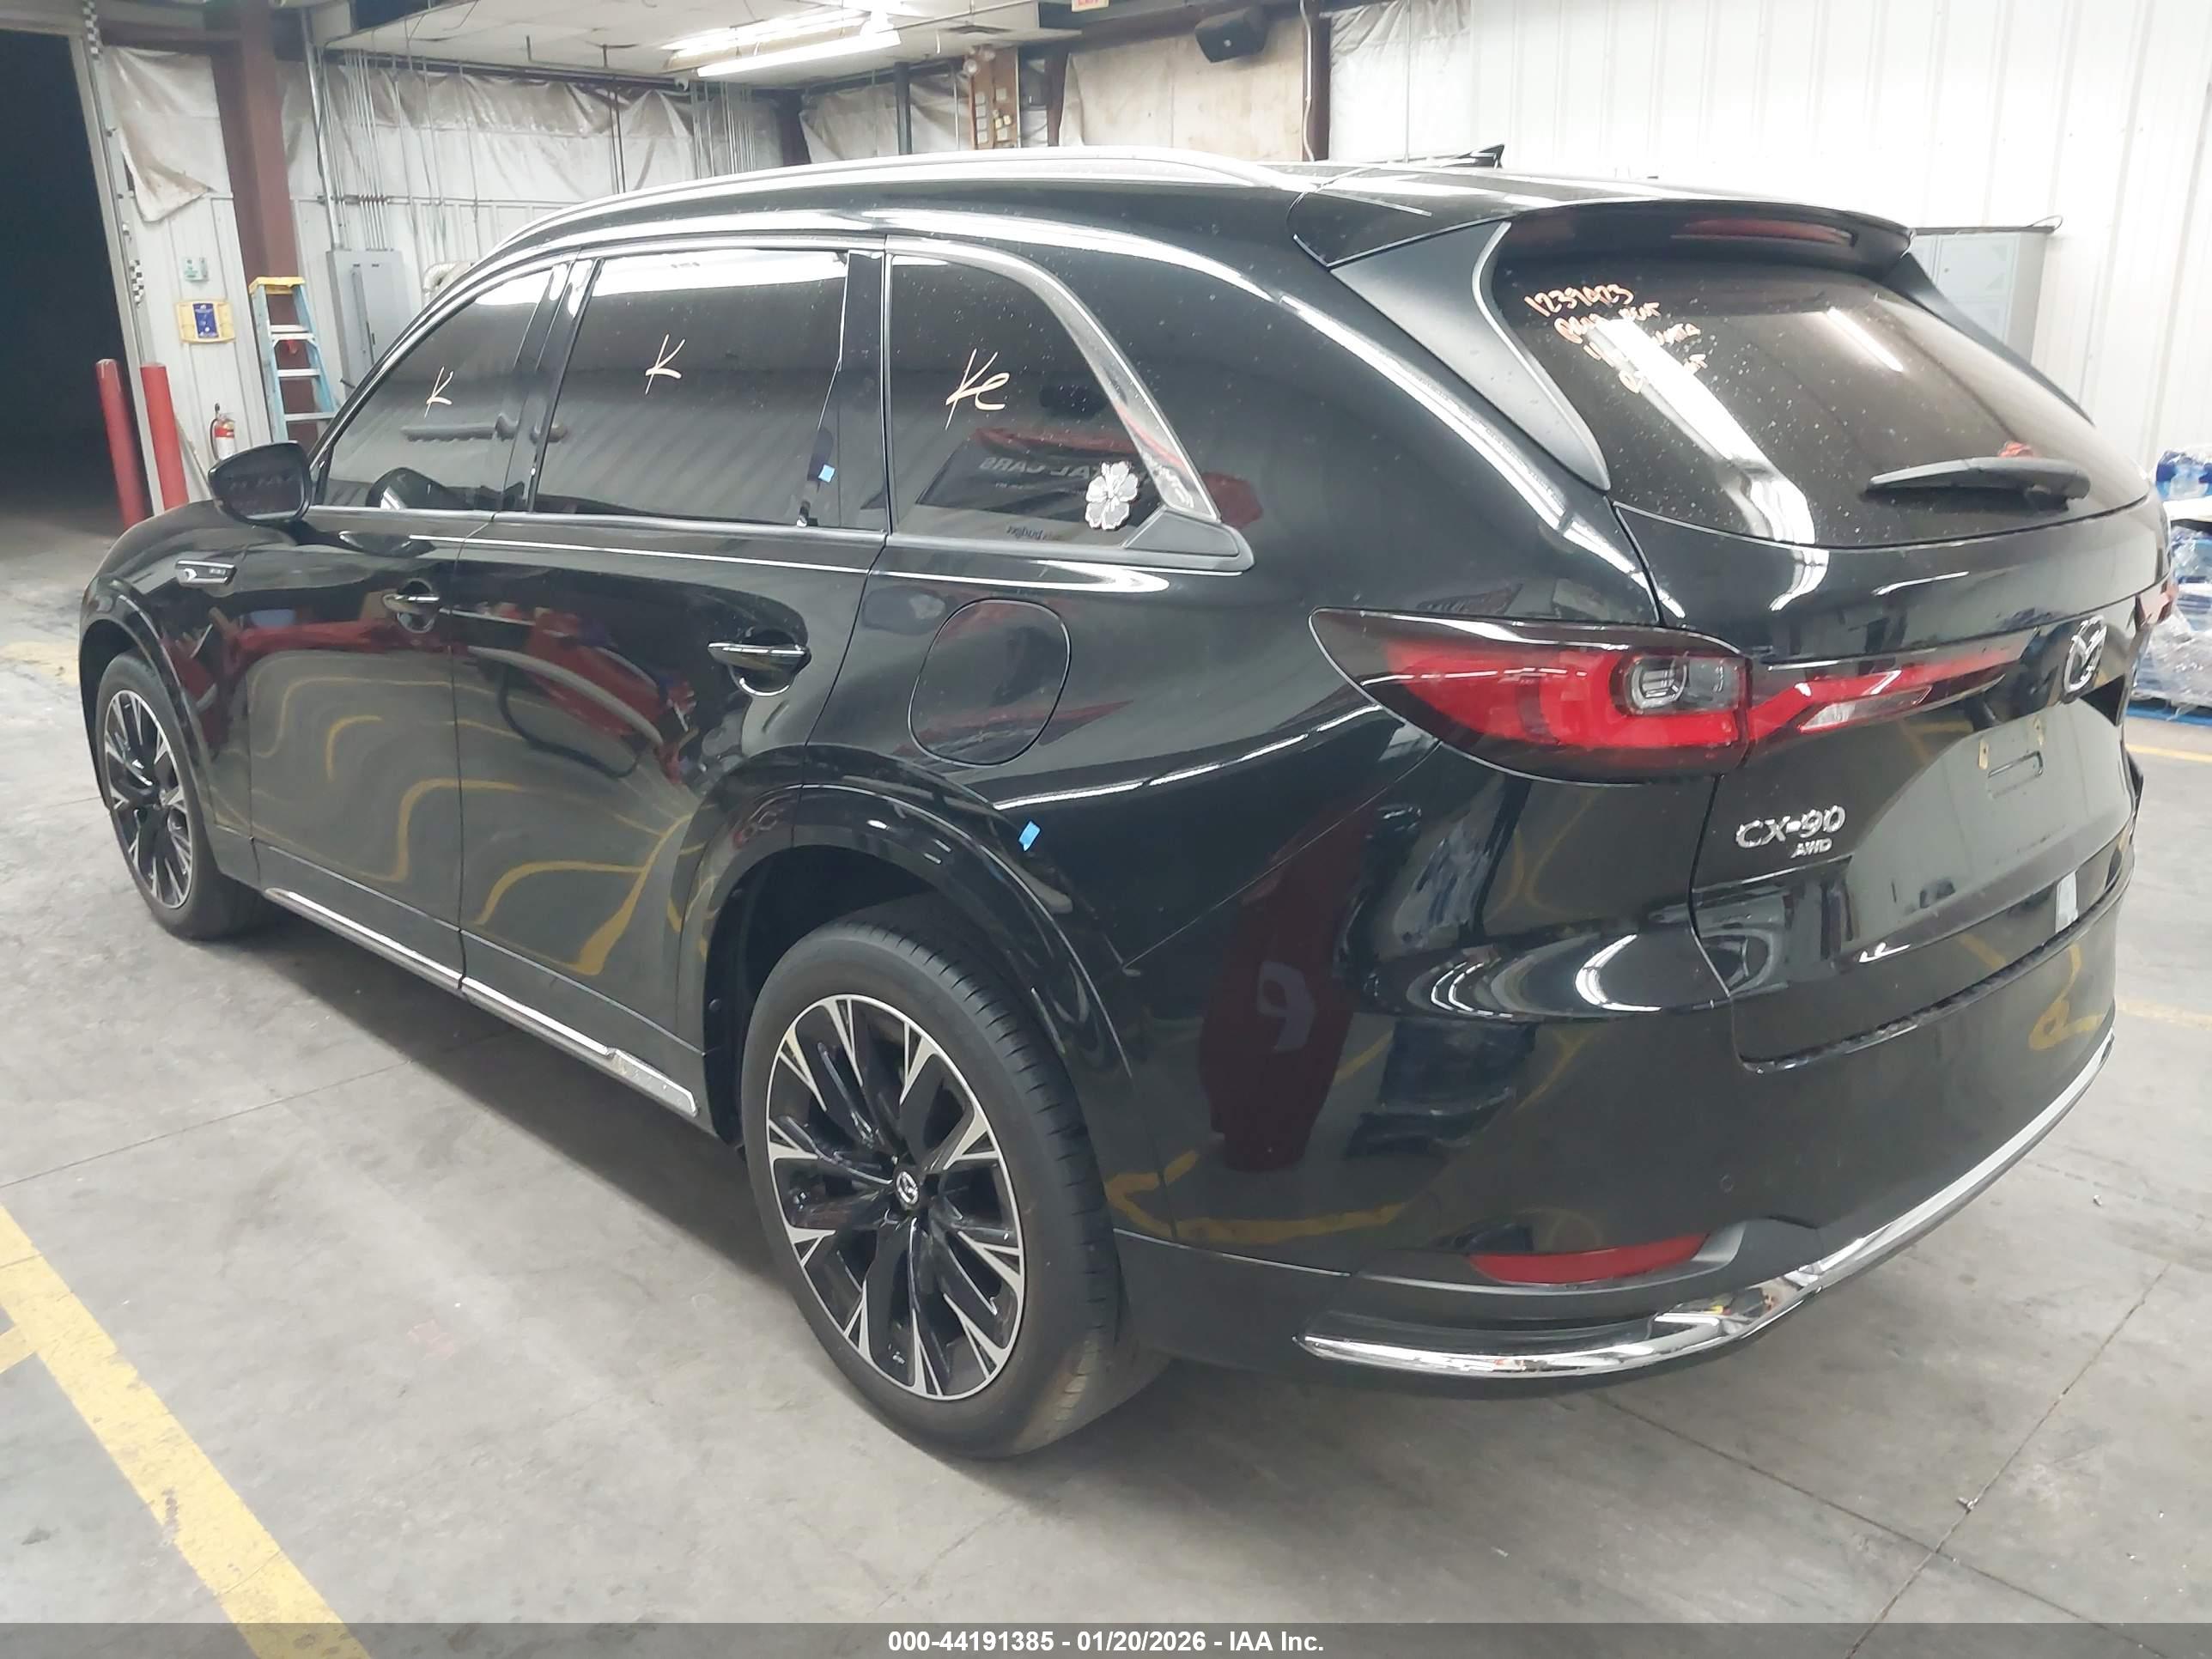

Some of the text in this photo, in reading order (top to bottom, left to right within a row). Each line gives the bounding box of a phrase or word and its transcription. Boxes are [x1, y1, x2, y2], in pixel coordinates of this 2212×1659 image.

[646, 333, 685, 394] K
[1735, 805, 1846, 848] CX-90
[1790, 838, 1832, 859] AWD
